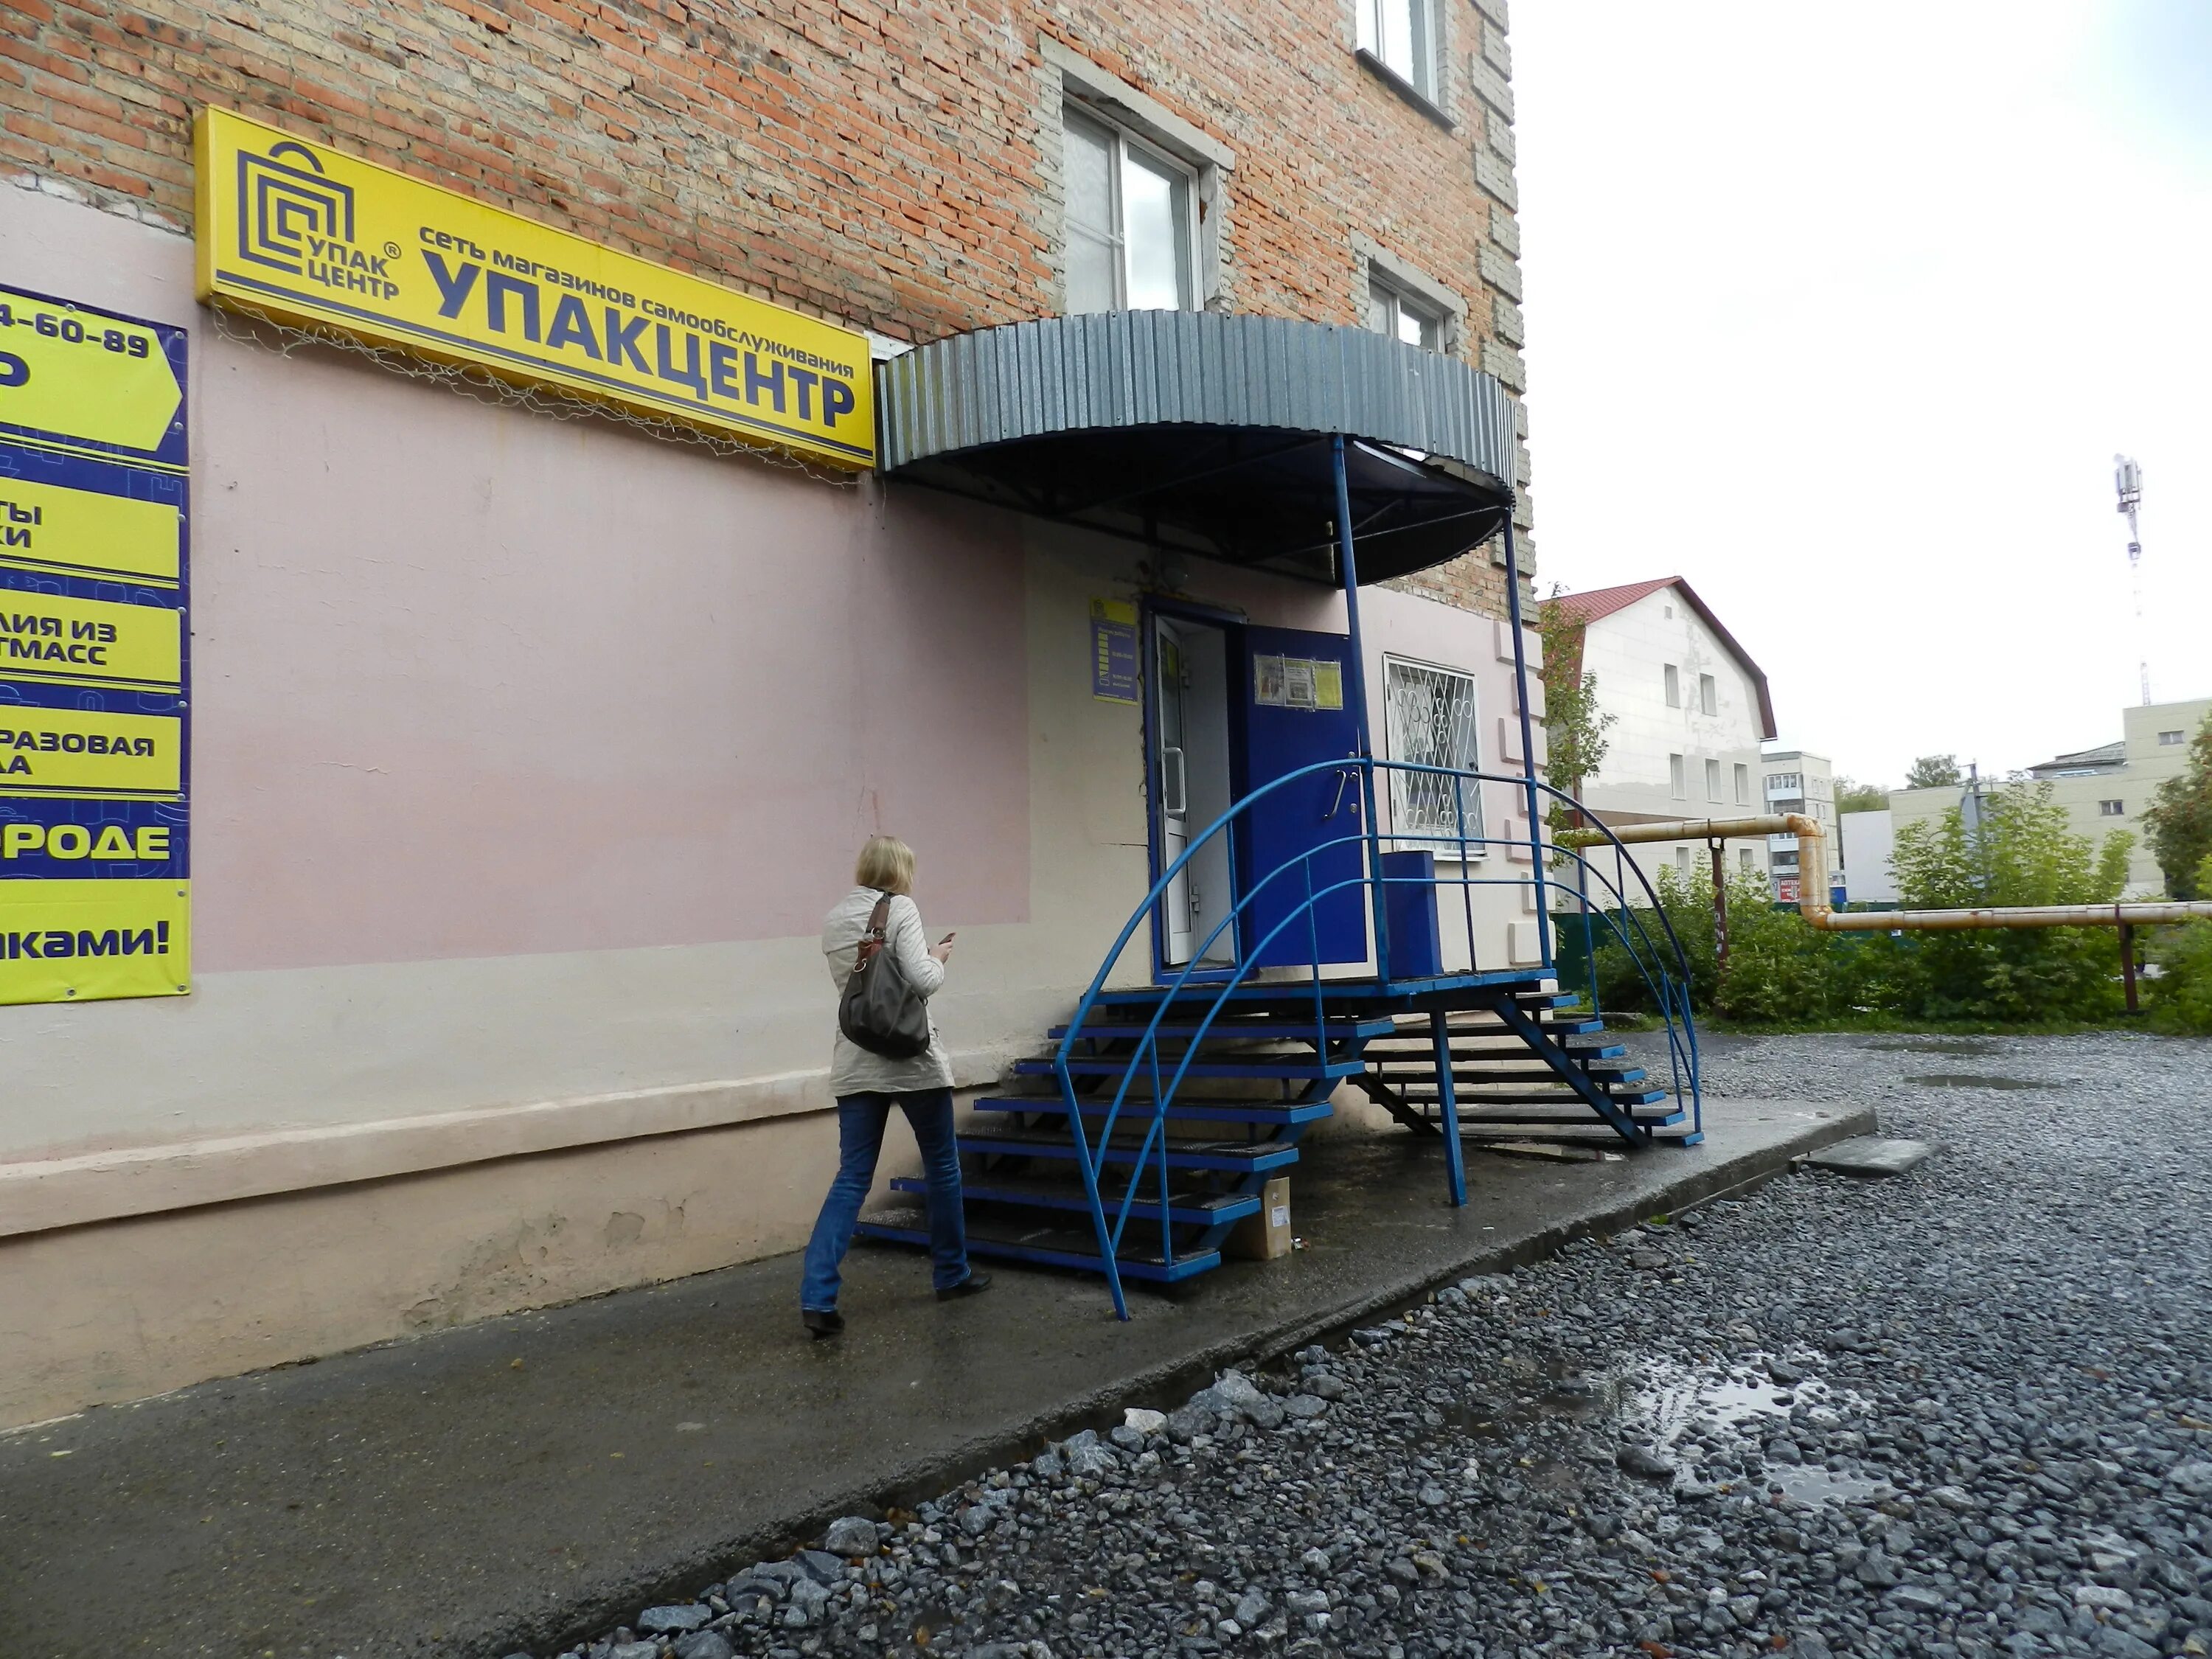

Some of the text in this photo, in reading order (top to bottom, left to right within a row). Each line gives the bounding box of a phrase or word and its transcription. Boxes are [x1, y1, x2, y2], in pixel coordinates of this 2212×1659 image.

[307, 234, 389, 278] УПАК
[308, 260, 400, 301] ЦЕНТР
[420, 226, 854, 380] сеть магазинов самообслуживания
[420, 248, 855, 428] УПАКЦЕНТР
[72, 619, 117, 644] ИЗ
[0, 823, 171, 860] РОДЕ
[0, 919, 170, 959] ками!
